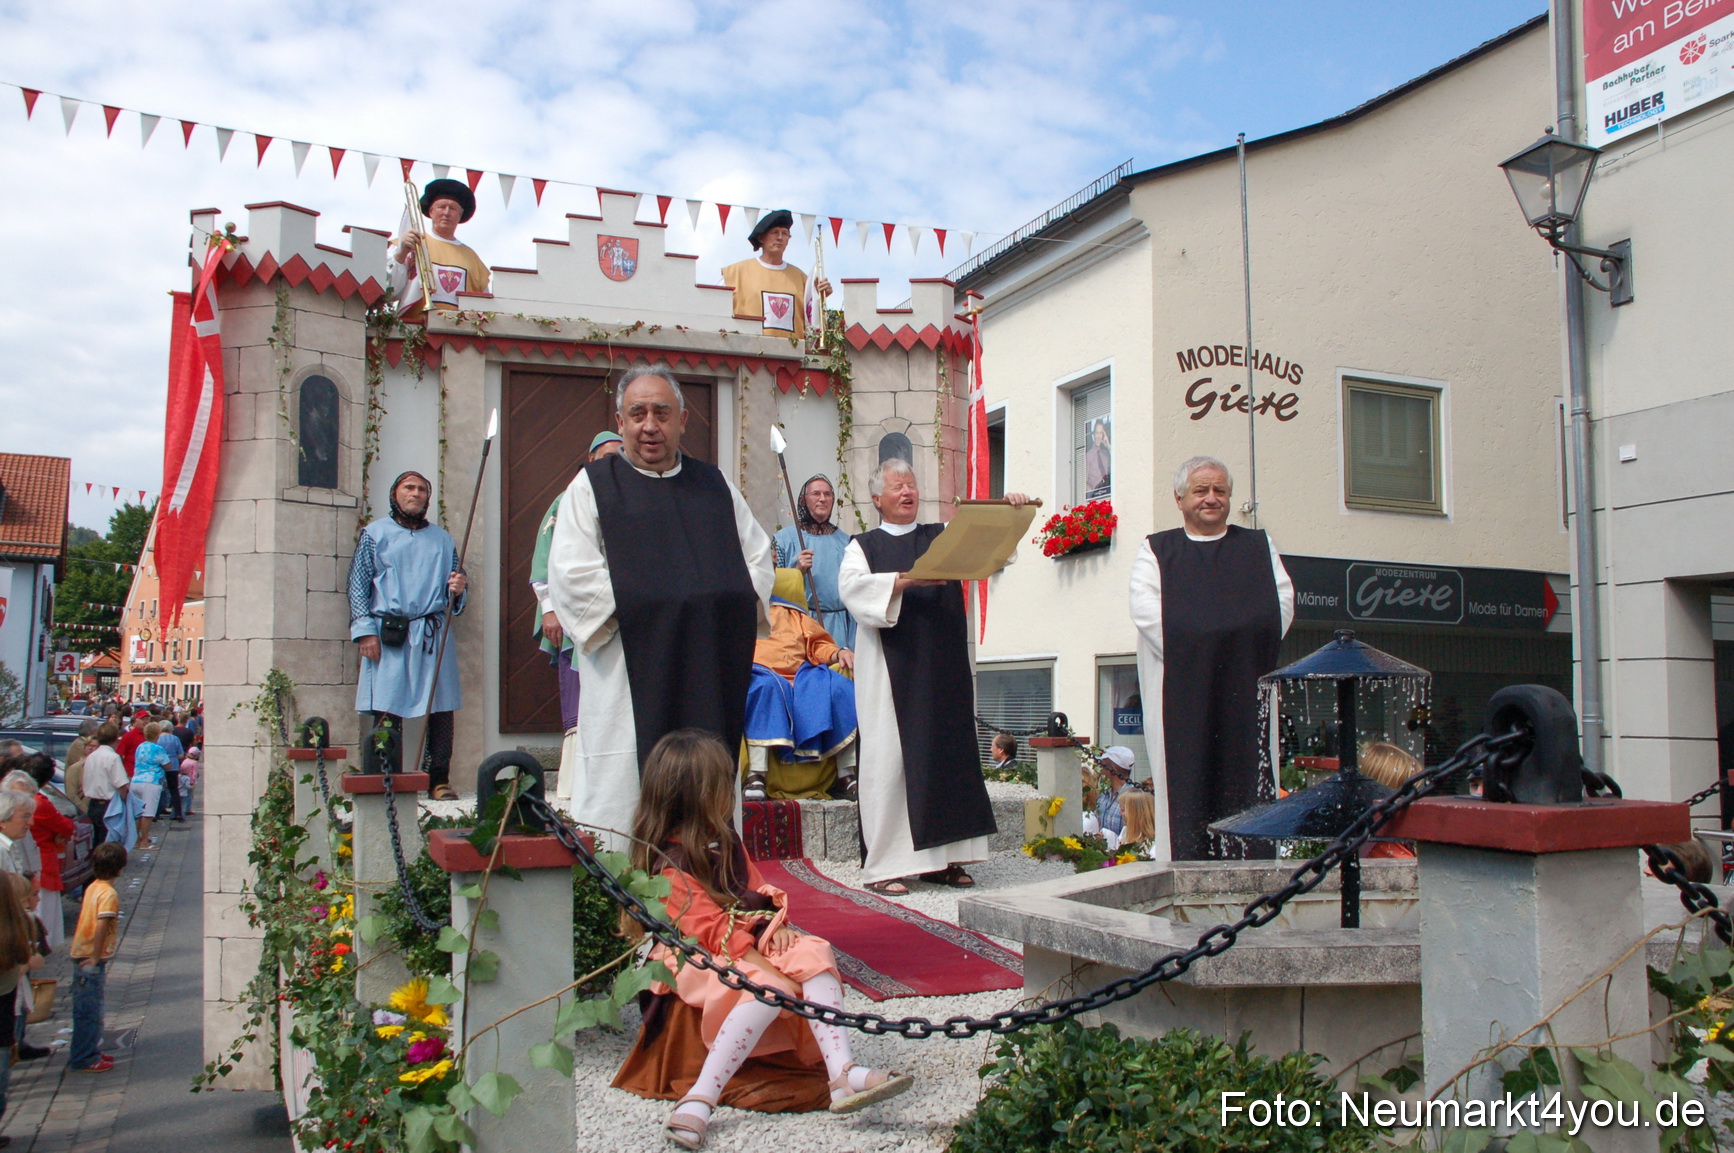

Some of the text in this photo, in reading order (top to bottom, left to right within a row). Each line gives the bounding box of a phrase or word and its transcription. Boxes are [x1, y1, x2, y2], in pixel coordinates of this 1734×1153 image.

[1613, 20, 1655, 54] am
[1602, 63, 1650, 91] Bachhuber
[1630, 65, 1666, 86] Partner
[1605, 91, 1664, 128] HUBER
[1176, 345, 1304, 385] MODEHAUS
[1375, 567, 1437, 580] MODEZENTRUM
[1297, 592, 1338, 607] Männer
[1469, 602, 1548, 618] Mode für Damen
[1118, 716, 1141, 724] CECIL
